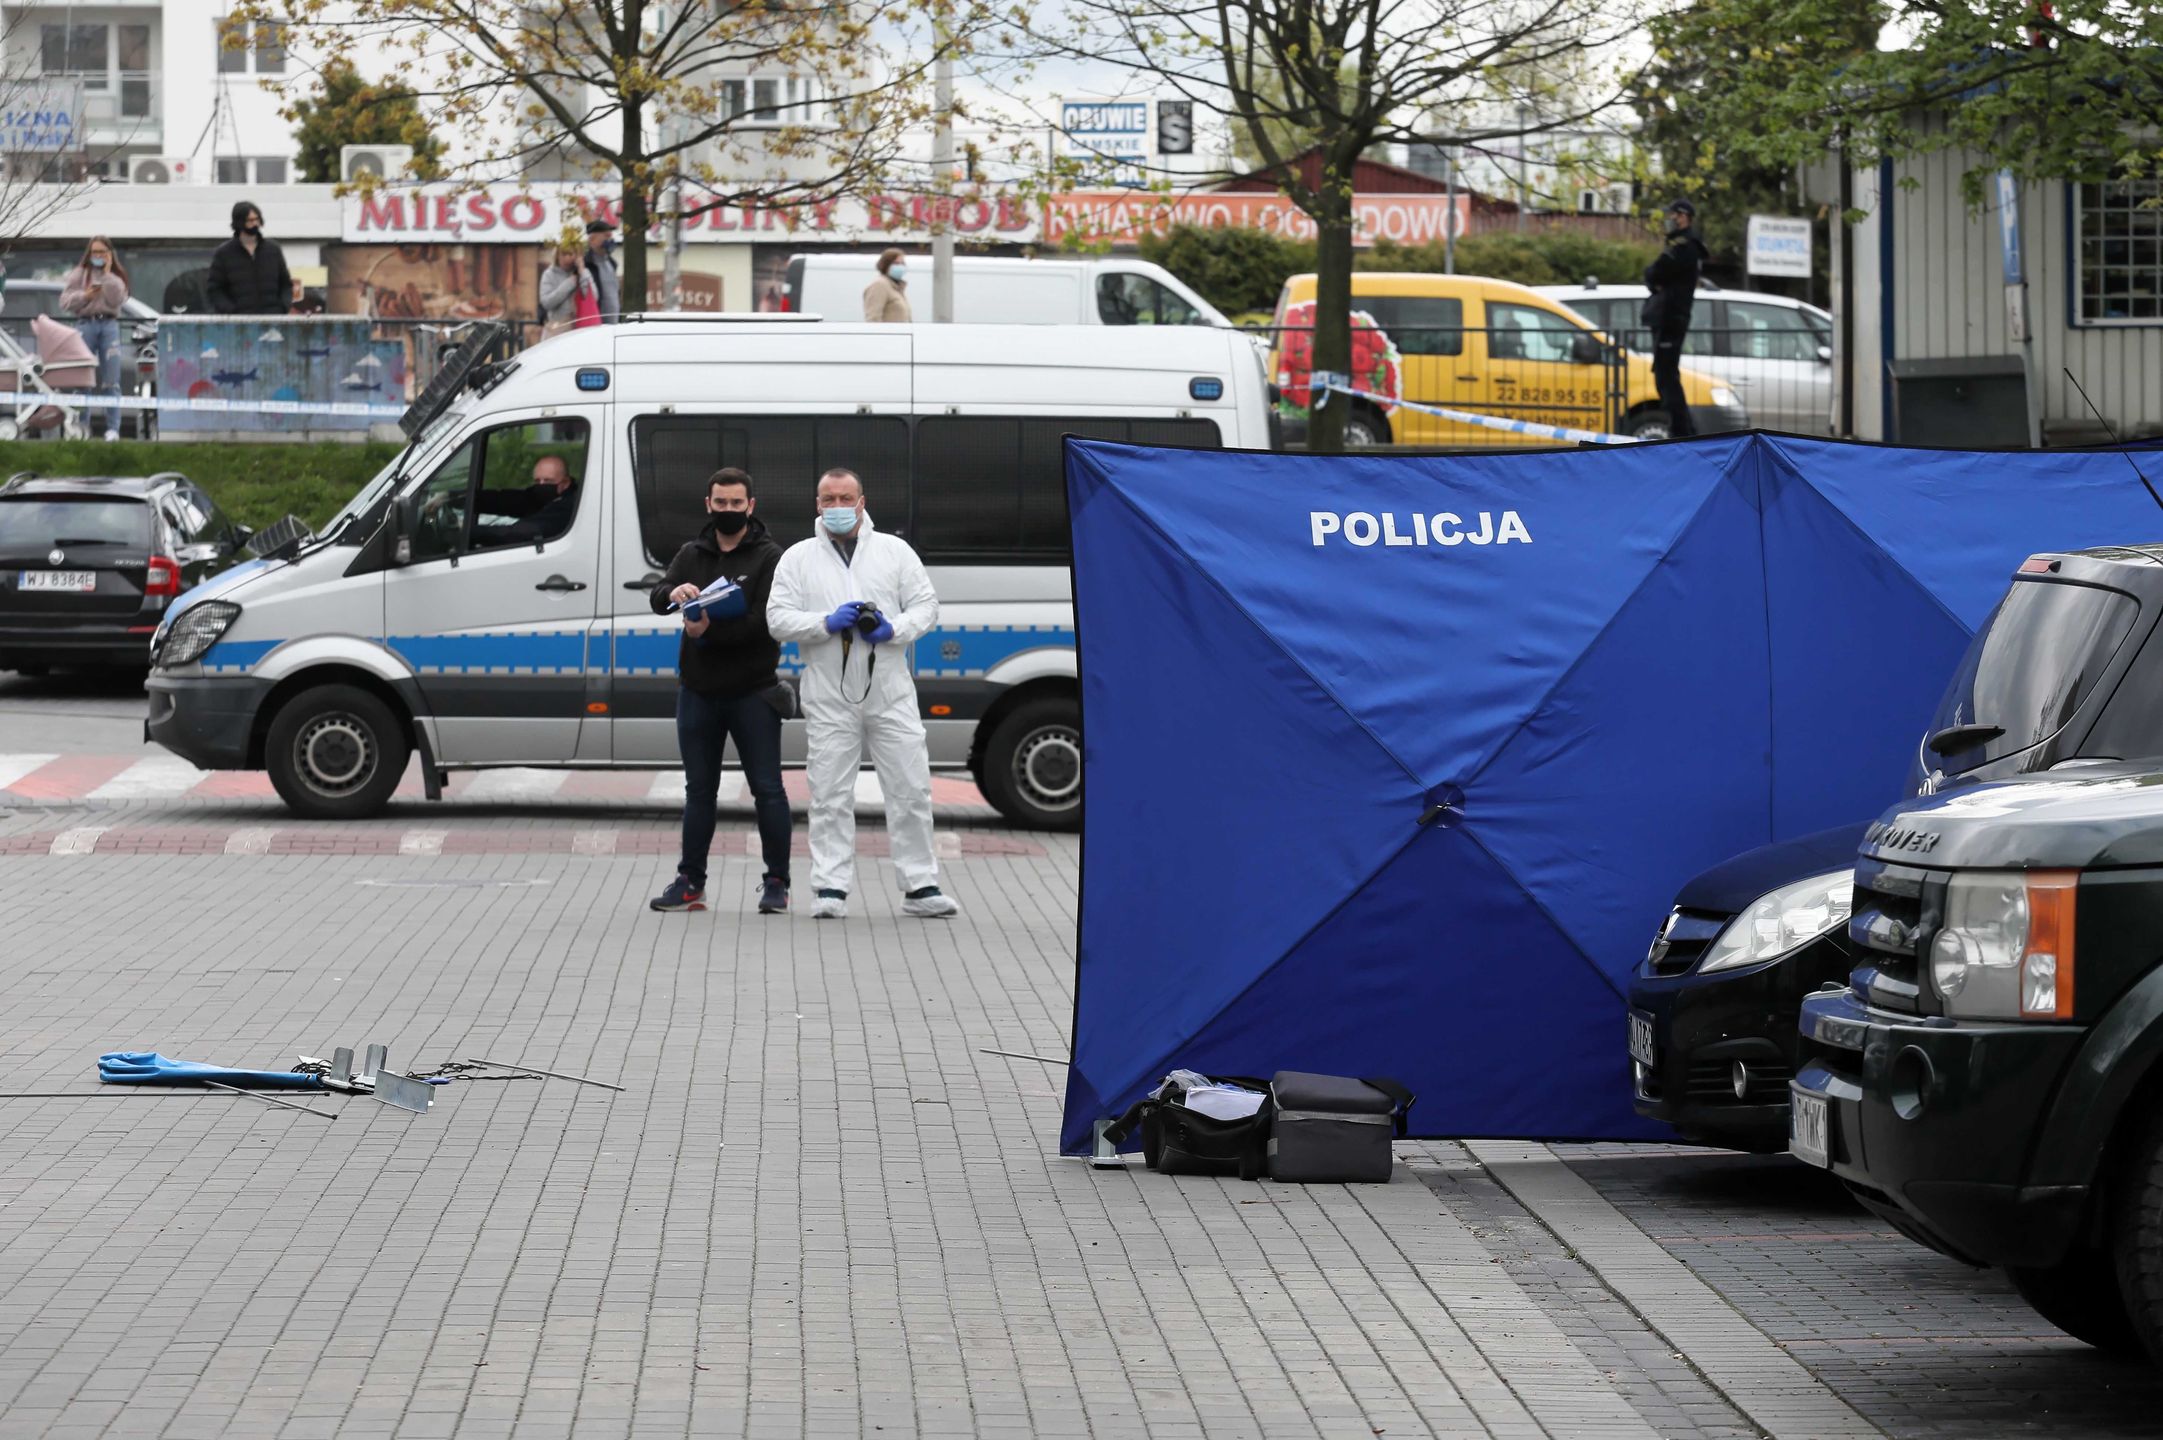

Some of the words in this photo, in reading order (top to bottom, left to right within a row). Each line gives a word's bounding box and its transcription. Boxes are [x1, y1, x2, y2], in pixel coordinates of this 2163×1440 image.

[1065, 105, 1145, 131] OBUWIE
[357, 195, 545, 239] MIĘSO
[1049, 202, 1232, 238] KWIATOWO
[1310, 511, 1533, 547] POLICJA
